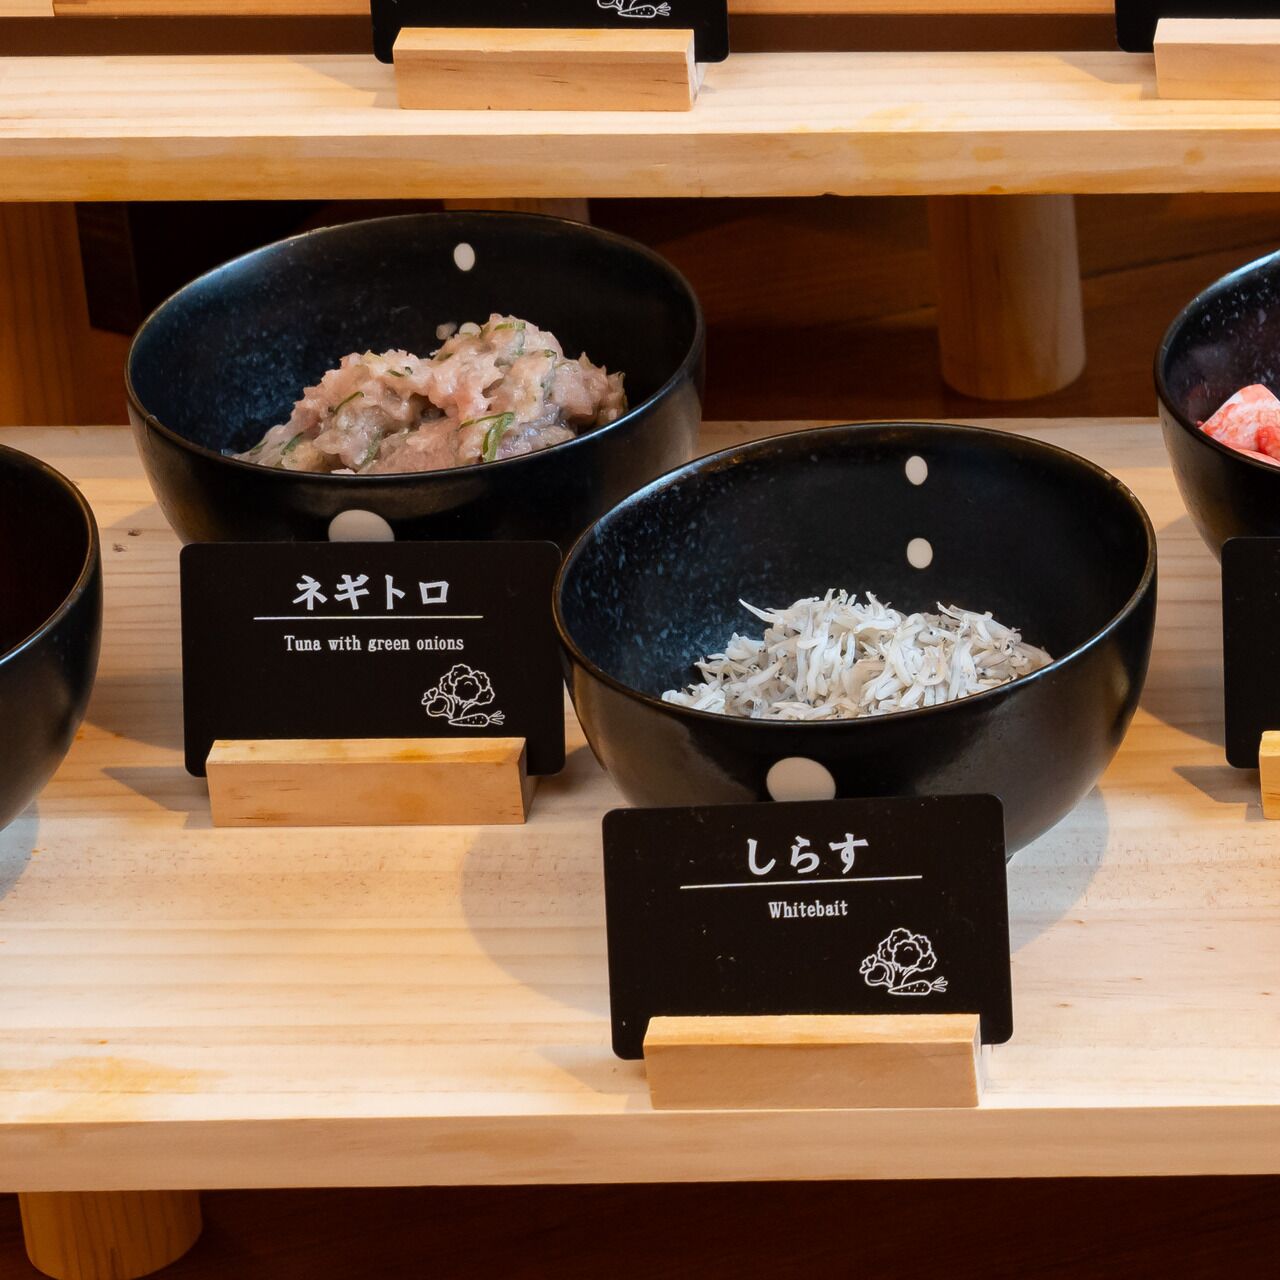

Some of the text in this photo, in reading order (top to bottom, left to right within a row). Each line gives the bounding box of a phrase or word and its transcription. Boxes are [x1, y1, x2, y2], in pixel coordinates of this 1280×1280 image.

[293, 574, 451, 612] ネギトロ
[284, 635, 466, 654] Tuna with green onions
[747, 833, 870, 877] しらす
[768, 900, 850, 920] Whitebait
